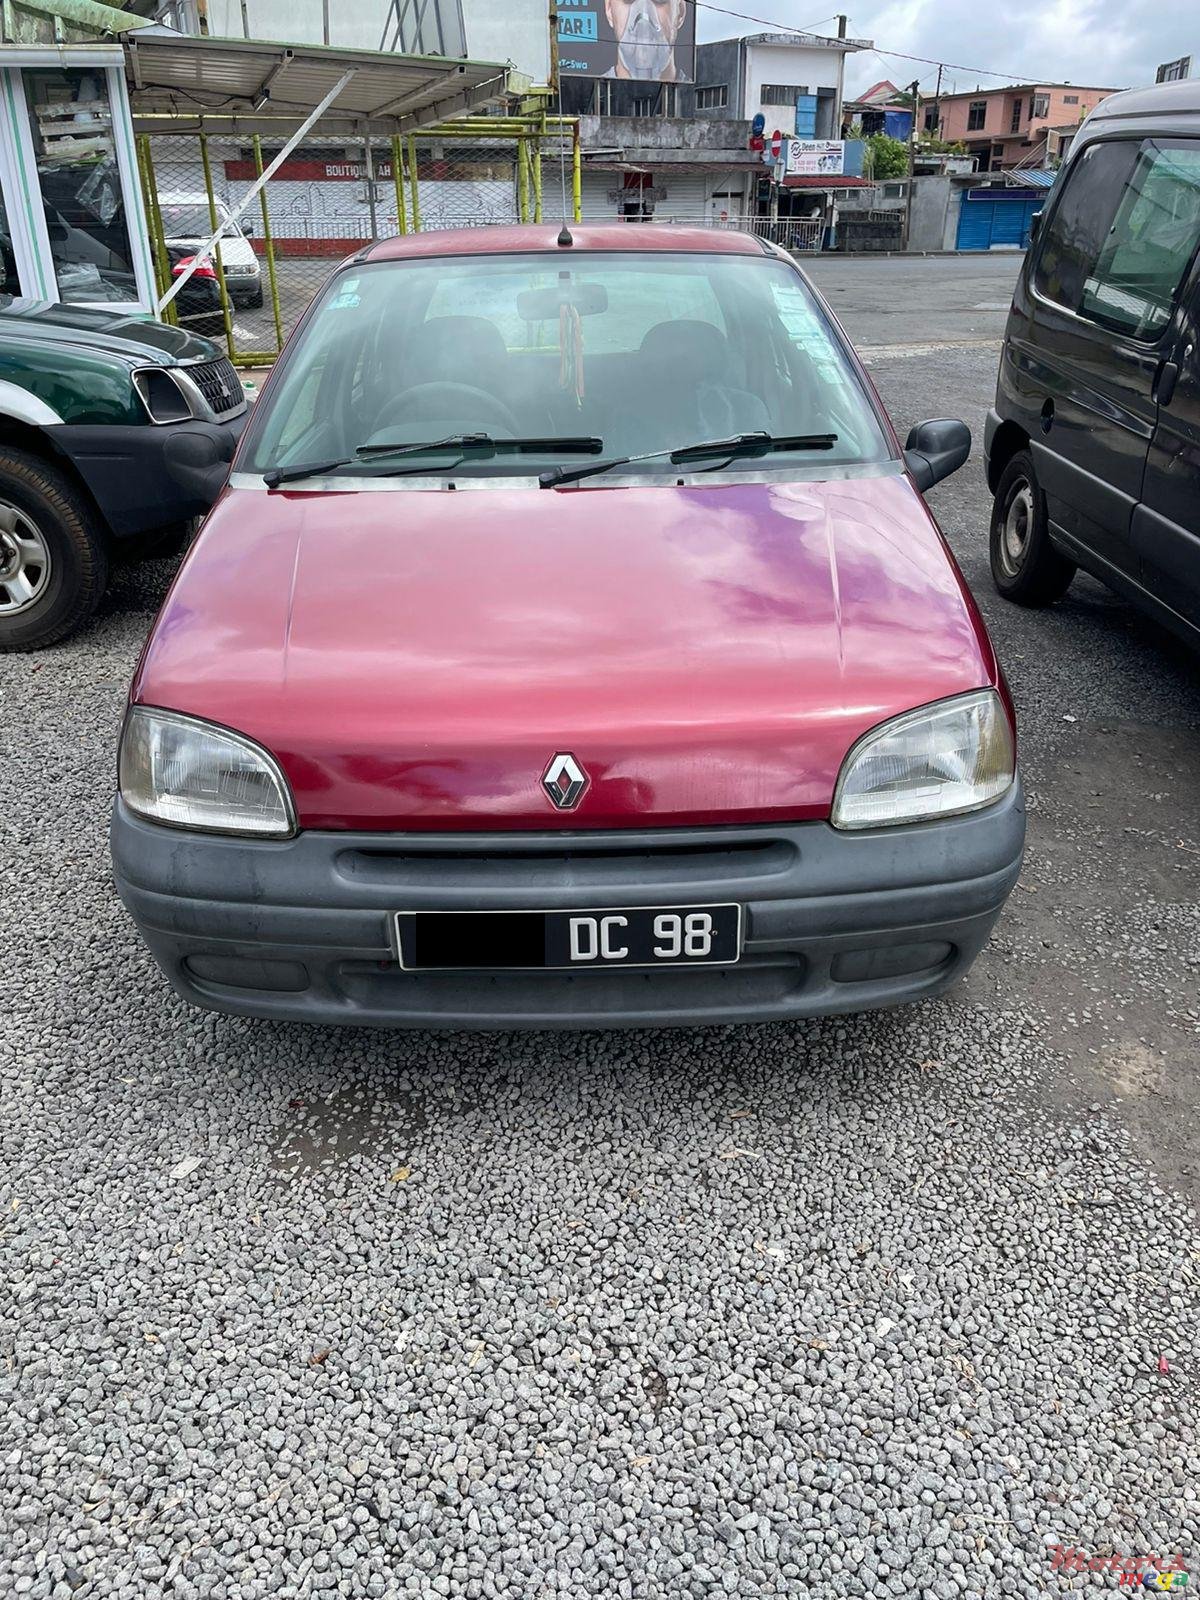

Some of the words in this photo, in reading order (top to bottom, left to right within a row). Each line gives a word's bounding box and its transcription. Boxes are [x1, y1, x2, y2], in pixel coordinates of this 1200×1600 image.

[325, 165, 367, 178] BOUTIQU
[569, 916, 629, 961] DC
[653, 913, 712, 958] 98
